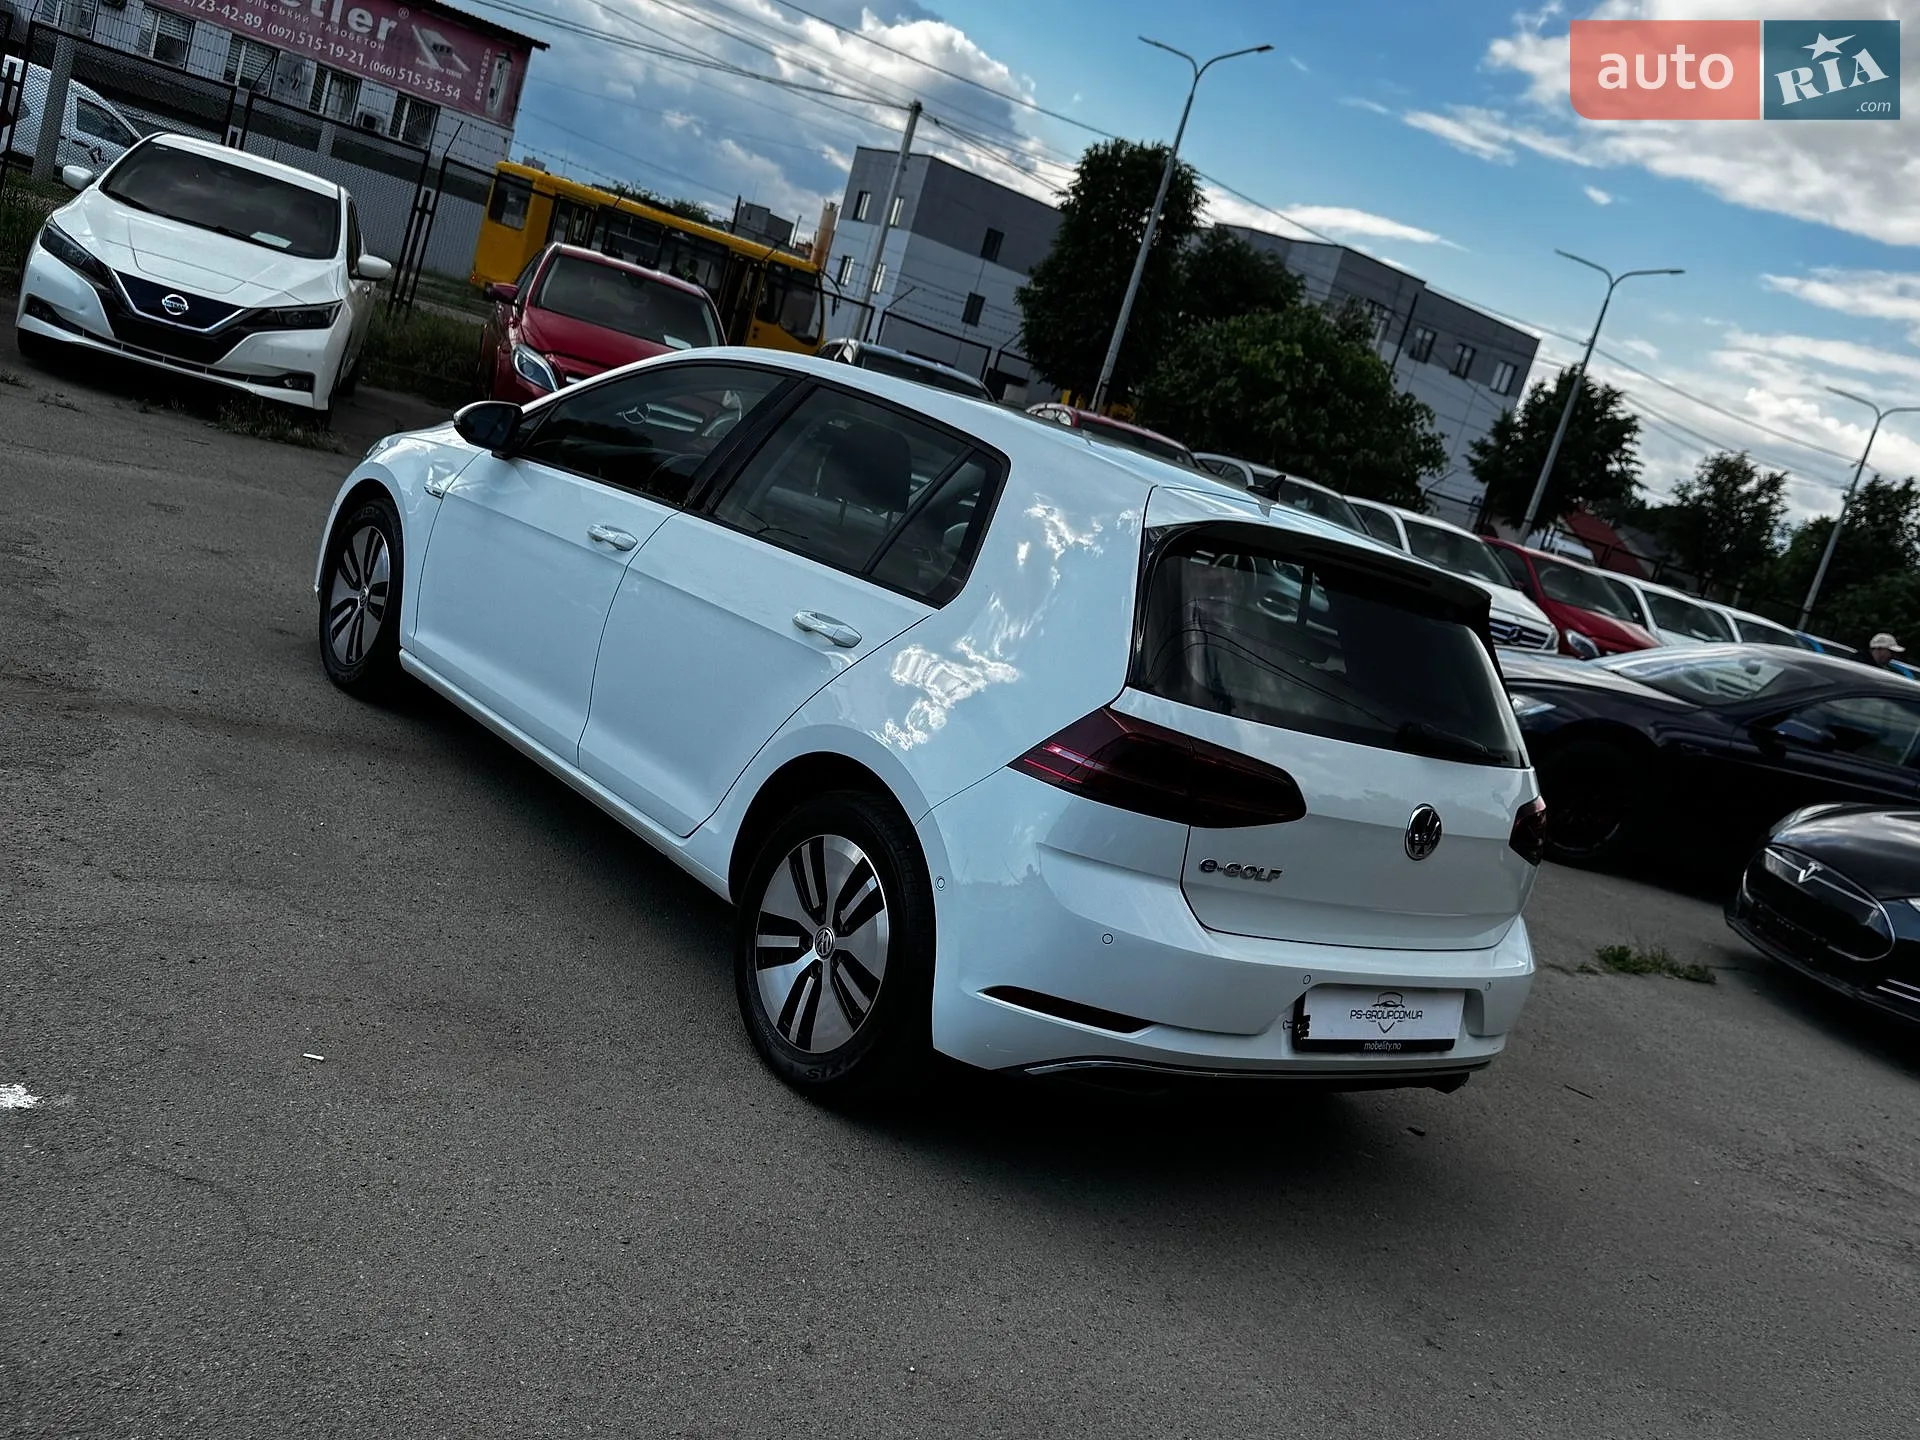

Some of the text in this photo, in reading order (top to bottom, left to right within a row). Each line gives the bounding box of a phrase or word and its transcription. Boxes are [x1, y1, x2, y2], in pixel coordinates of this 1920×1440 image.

[267, 22, 296, 43] (097)
[369, 60, 396, 79] (066)
[398, 67, 461, 100] 515-55-54
